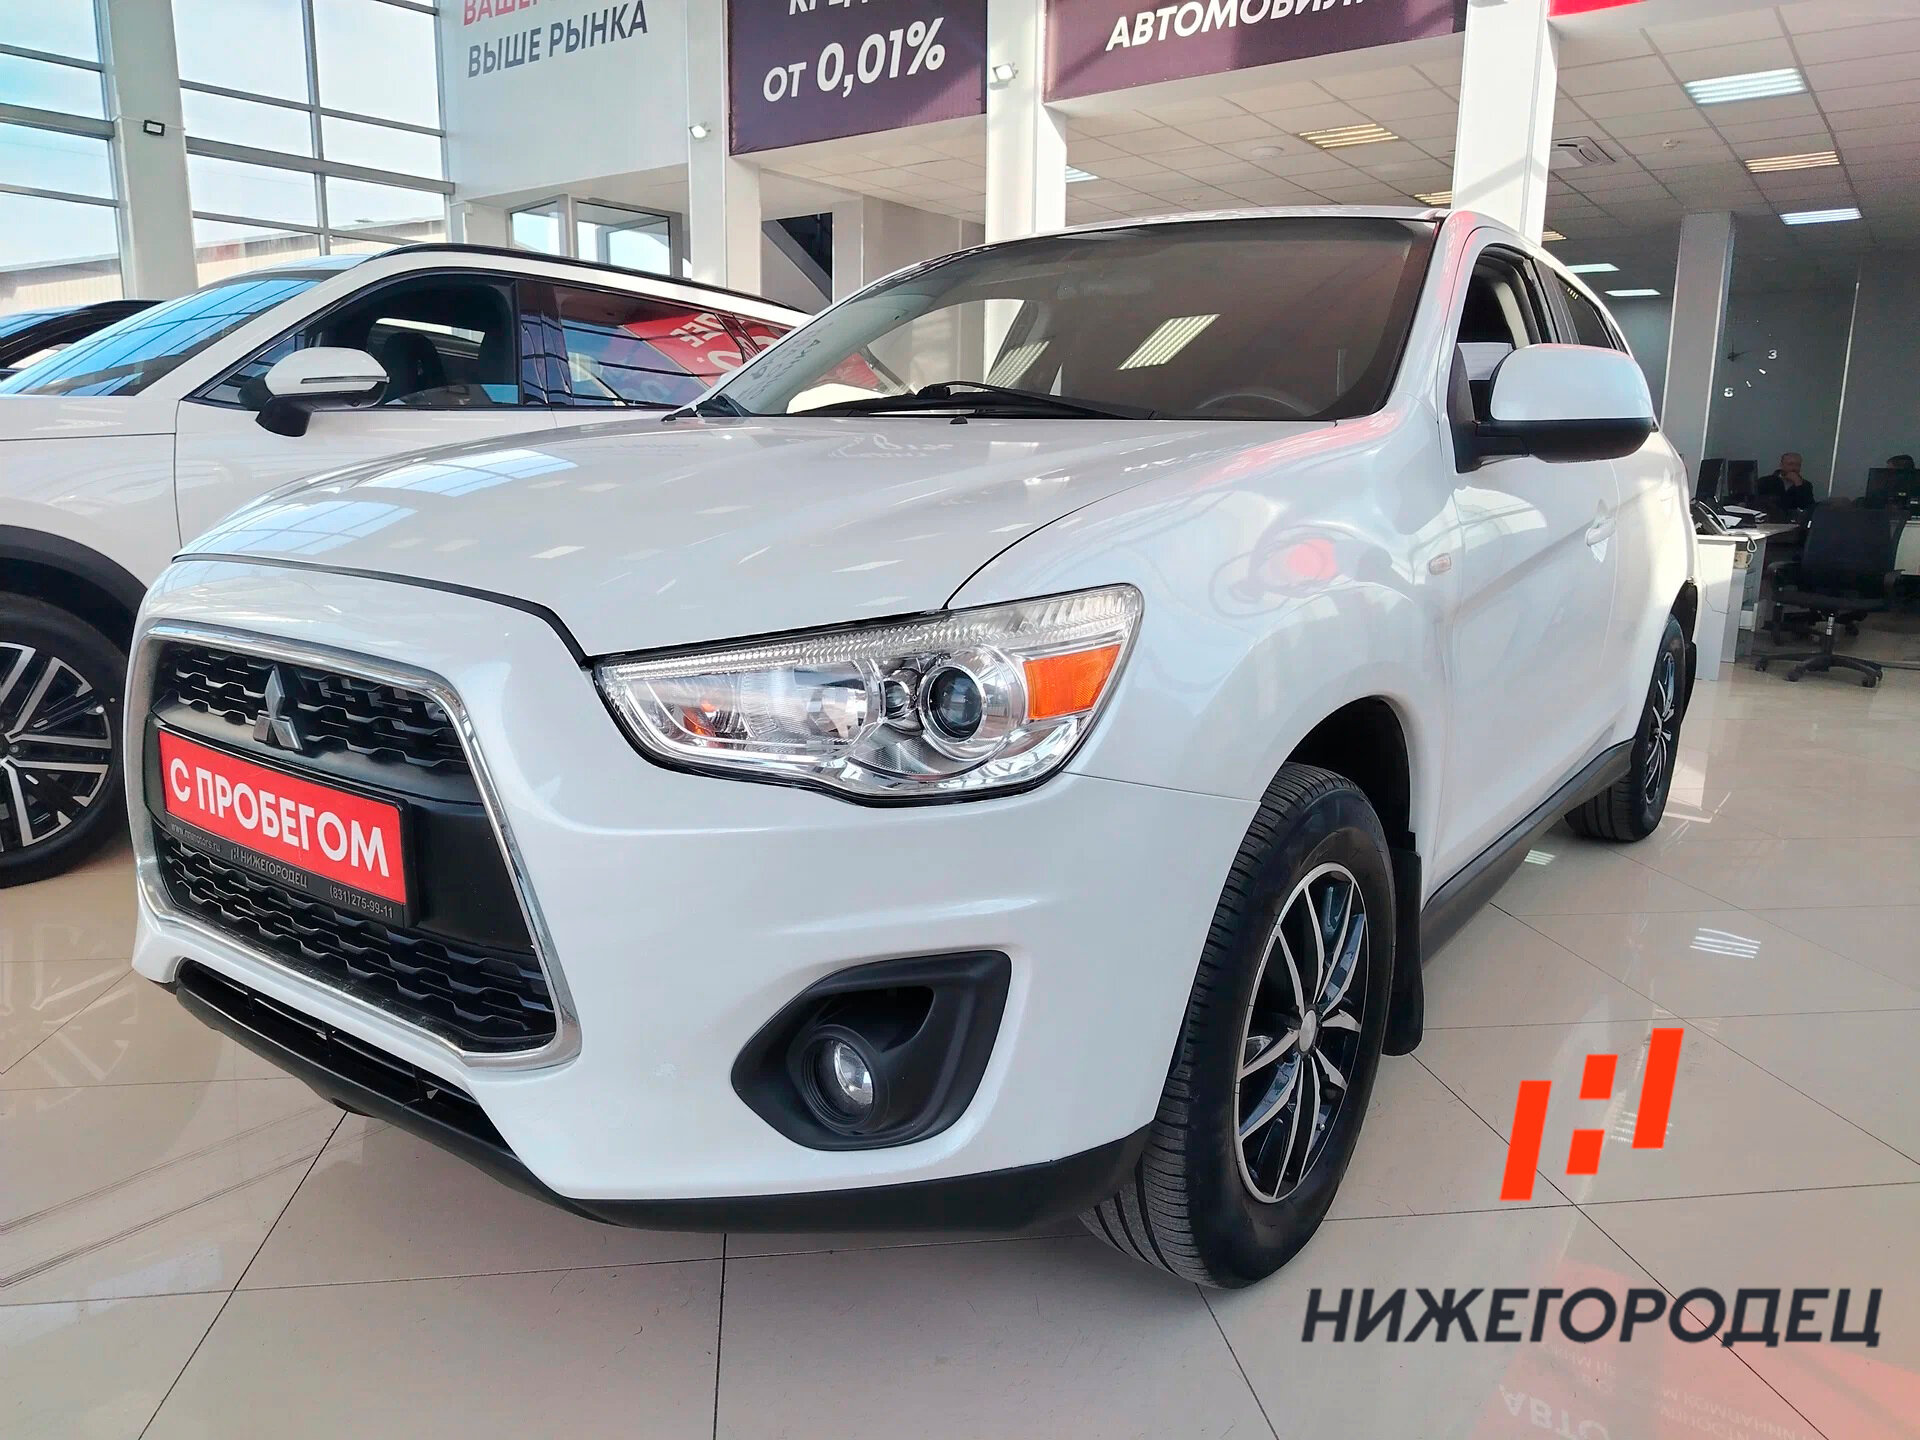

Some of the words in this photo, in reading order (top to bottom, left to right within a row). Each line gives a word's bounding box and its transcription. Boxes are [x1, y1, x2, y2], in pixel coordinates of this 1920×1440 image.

[468, 27, 542, 78] ВЫШЕ
[549, 0, 648, 57] РЫНКА
[816, 17, 946, 98] 0,01%
[1768, 349, 1777, 359] 3
[170, 758, 191, 802] С
[196, 766, 389, 877] ПРОБЕГОМ
[240, 851, 308, 889] НИЖЕГОРОДЕЦ
